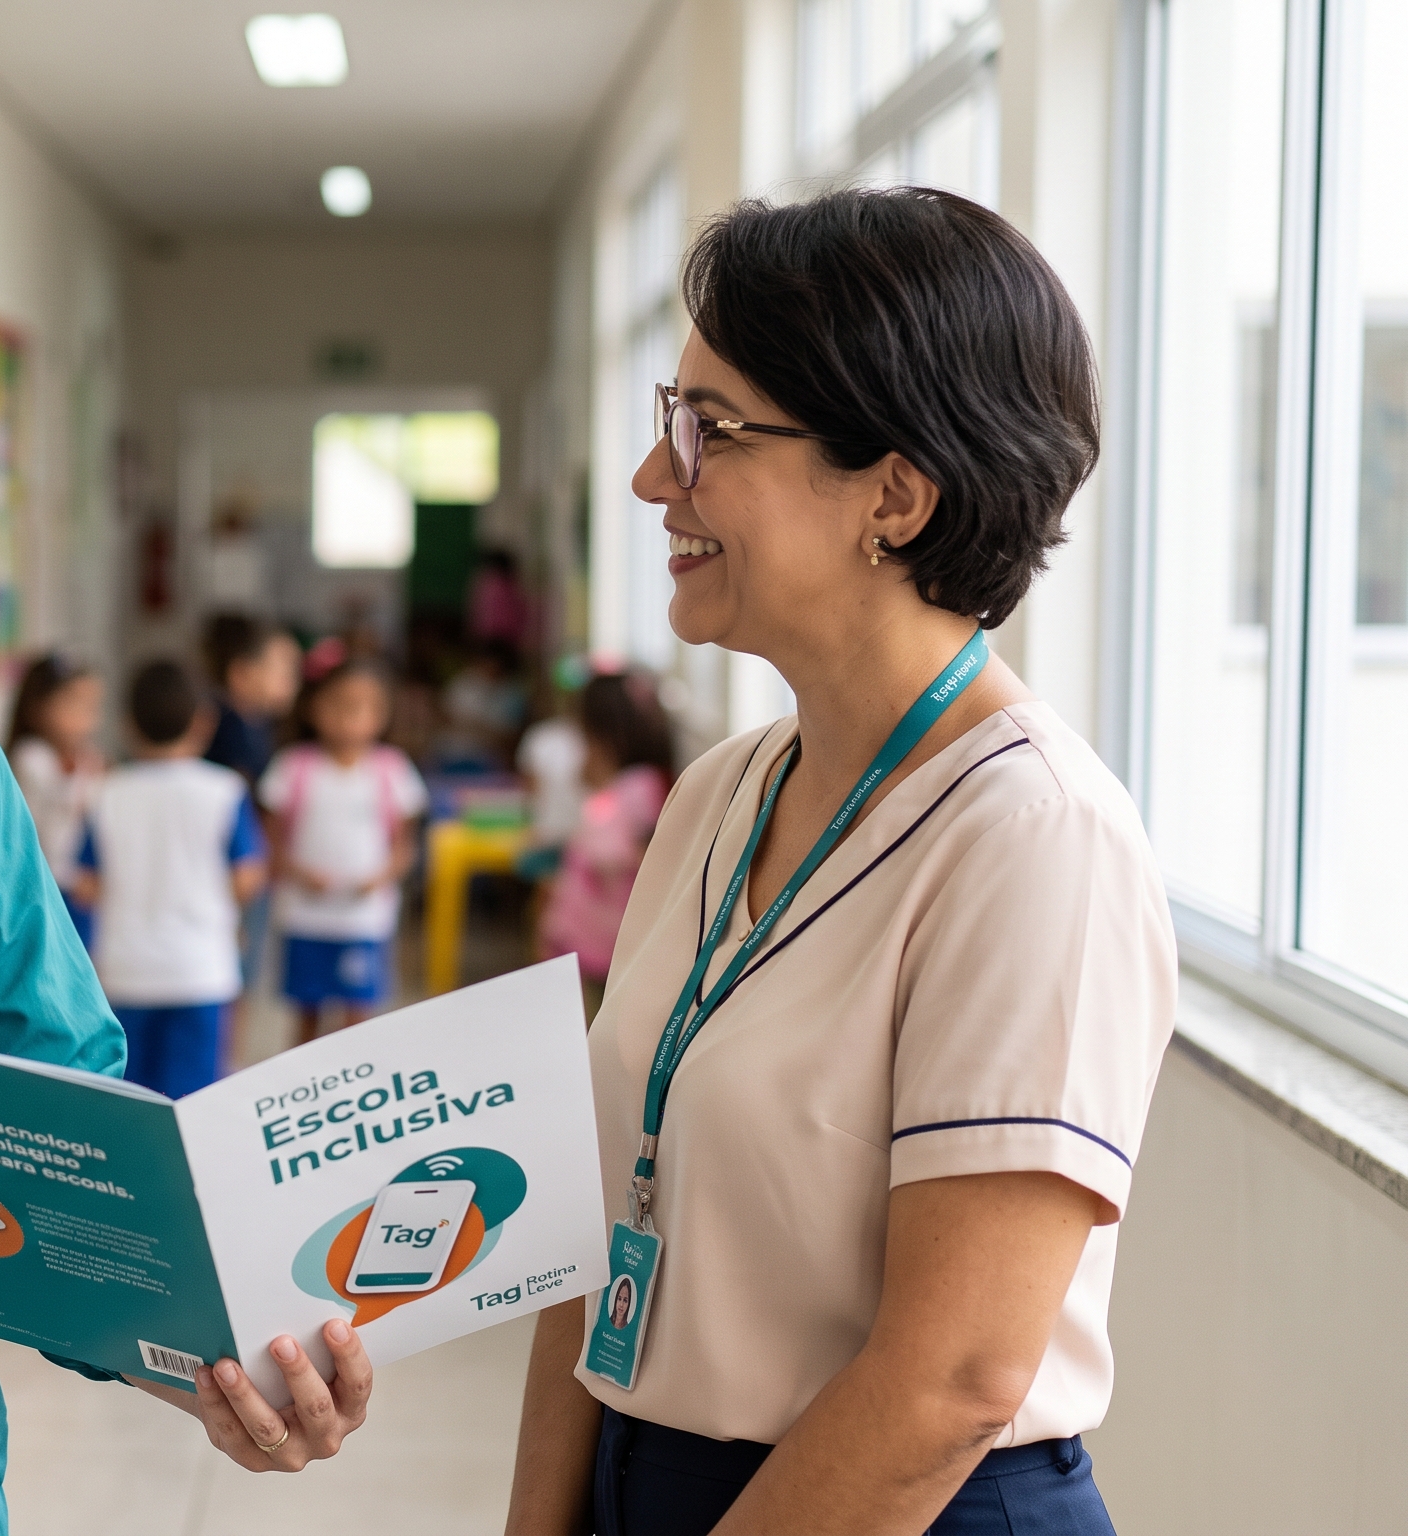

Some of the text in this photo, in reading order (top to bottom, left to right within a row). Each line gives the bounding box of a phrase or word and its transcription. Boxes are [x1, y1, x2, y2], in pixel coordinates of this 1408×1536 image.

[254, 1062, 374, 1117] Projeto
[262, 1069, 439, 1151] Escola
[269, 1082, 515, 1185] Inclusiva
[381, 1224, 437, 1249] Tag
[526, 1264, 577, 1284] Rotina
[527, 1278, 564, 1295] Leve
[470, 1286, 522, 1311] Tag
